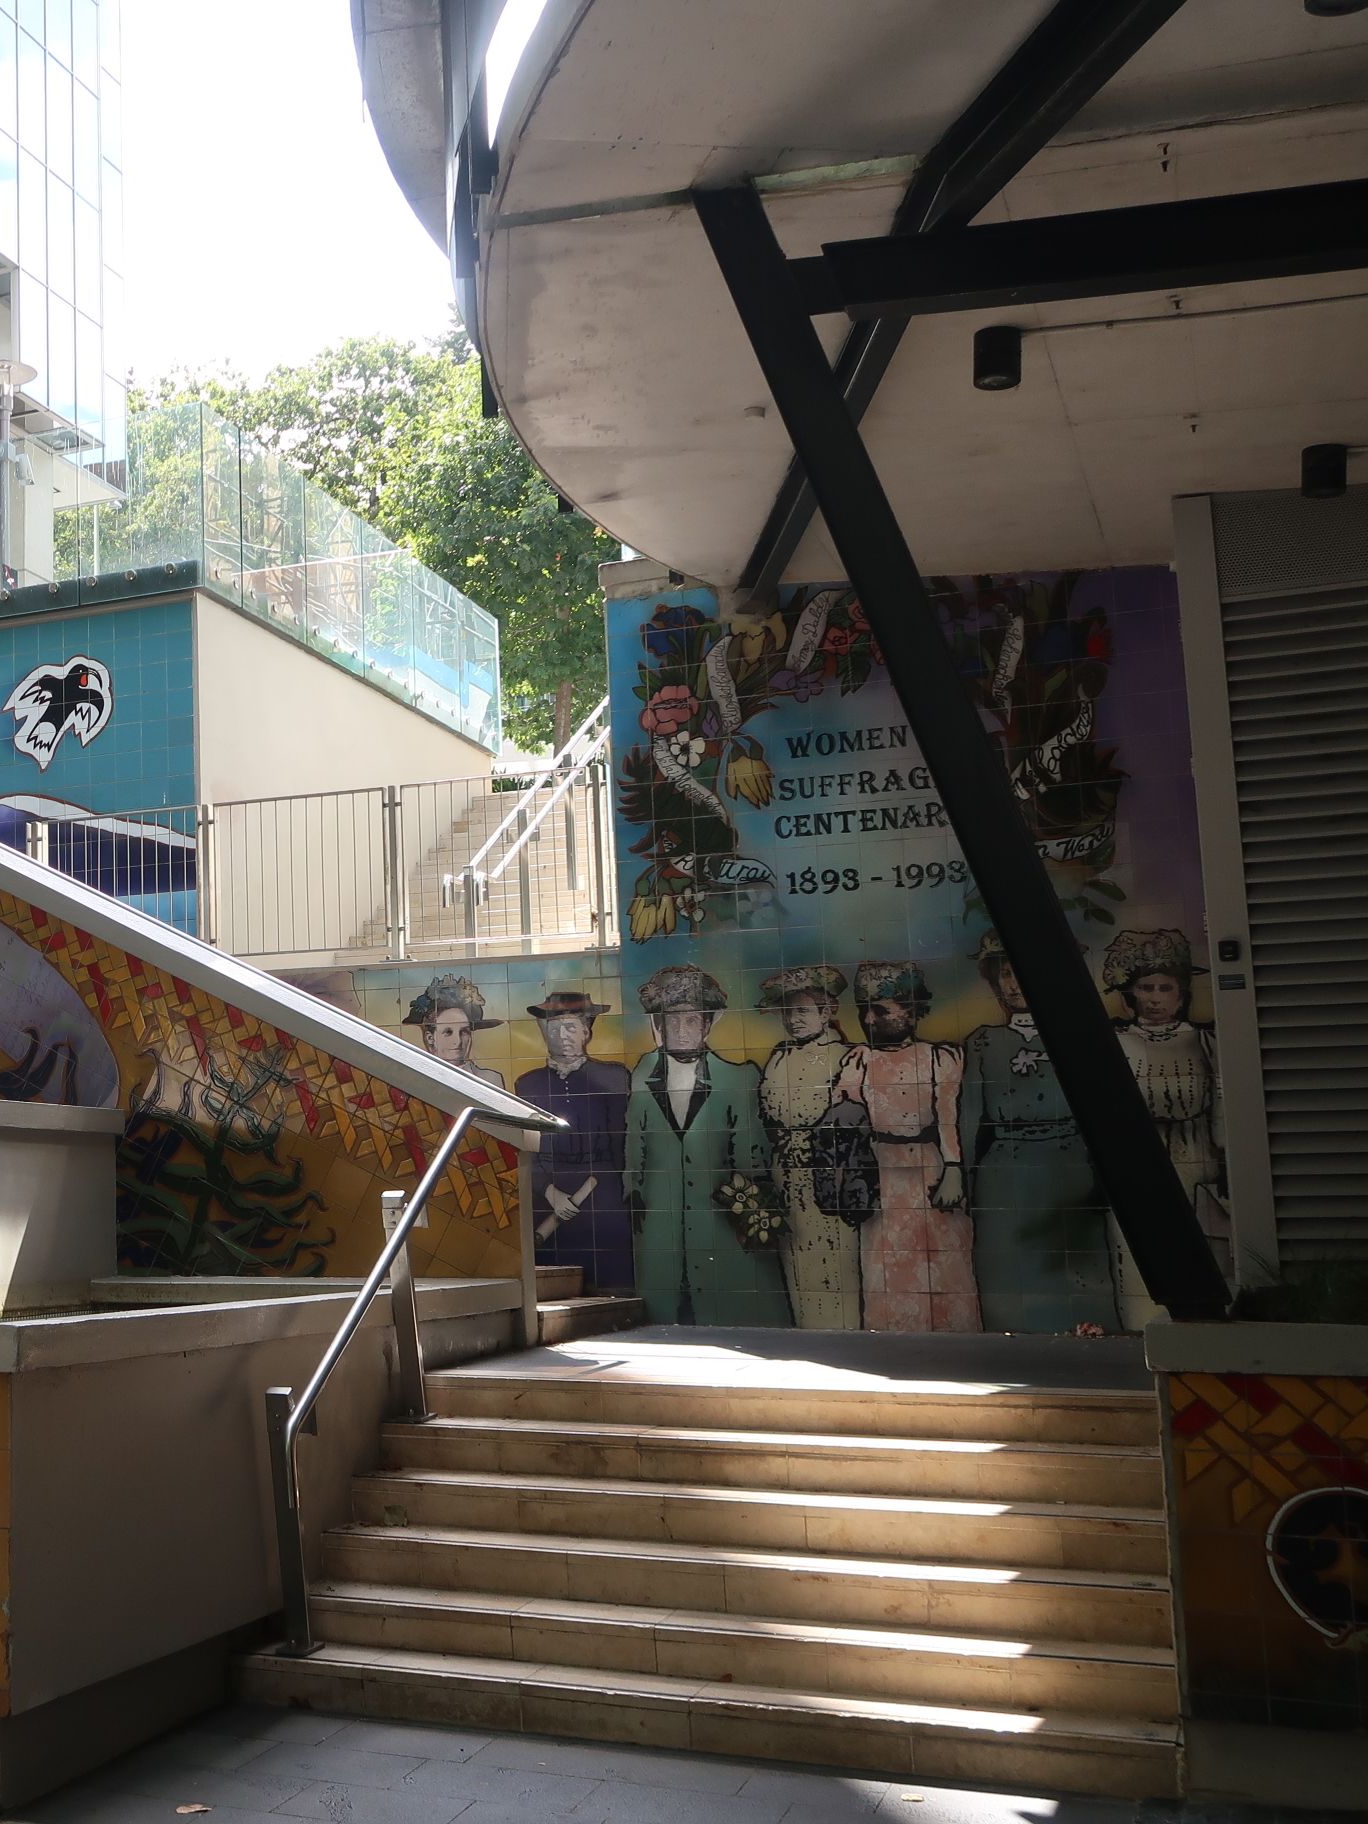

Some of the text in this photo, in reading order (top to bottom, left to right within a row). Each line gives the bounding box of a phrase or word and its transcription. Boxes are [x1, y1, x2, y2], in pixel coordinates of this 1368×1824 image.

[785, 725, 907, 759] WOMEN
[779, 766, 937, 801] SUFFRAG
[774, 802, 949, 839] CENTENAR
[786, 866, 861, 894] 1893
[891, 860, 967, 889] 1993
